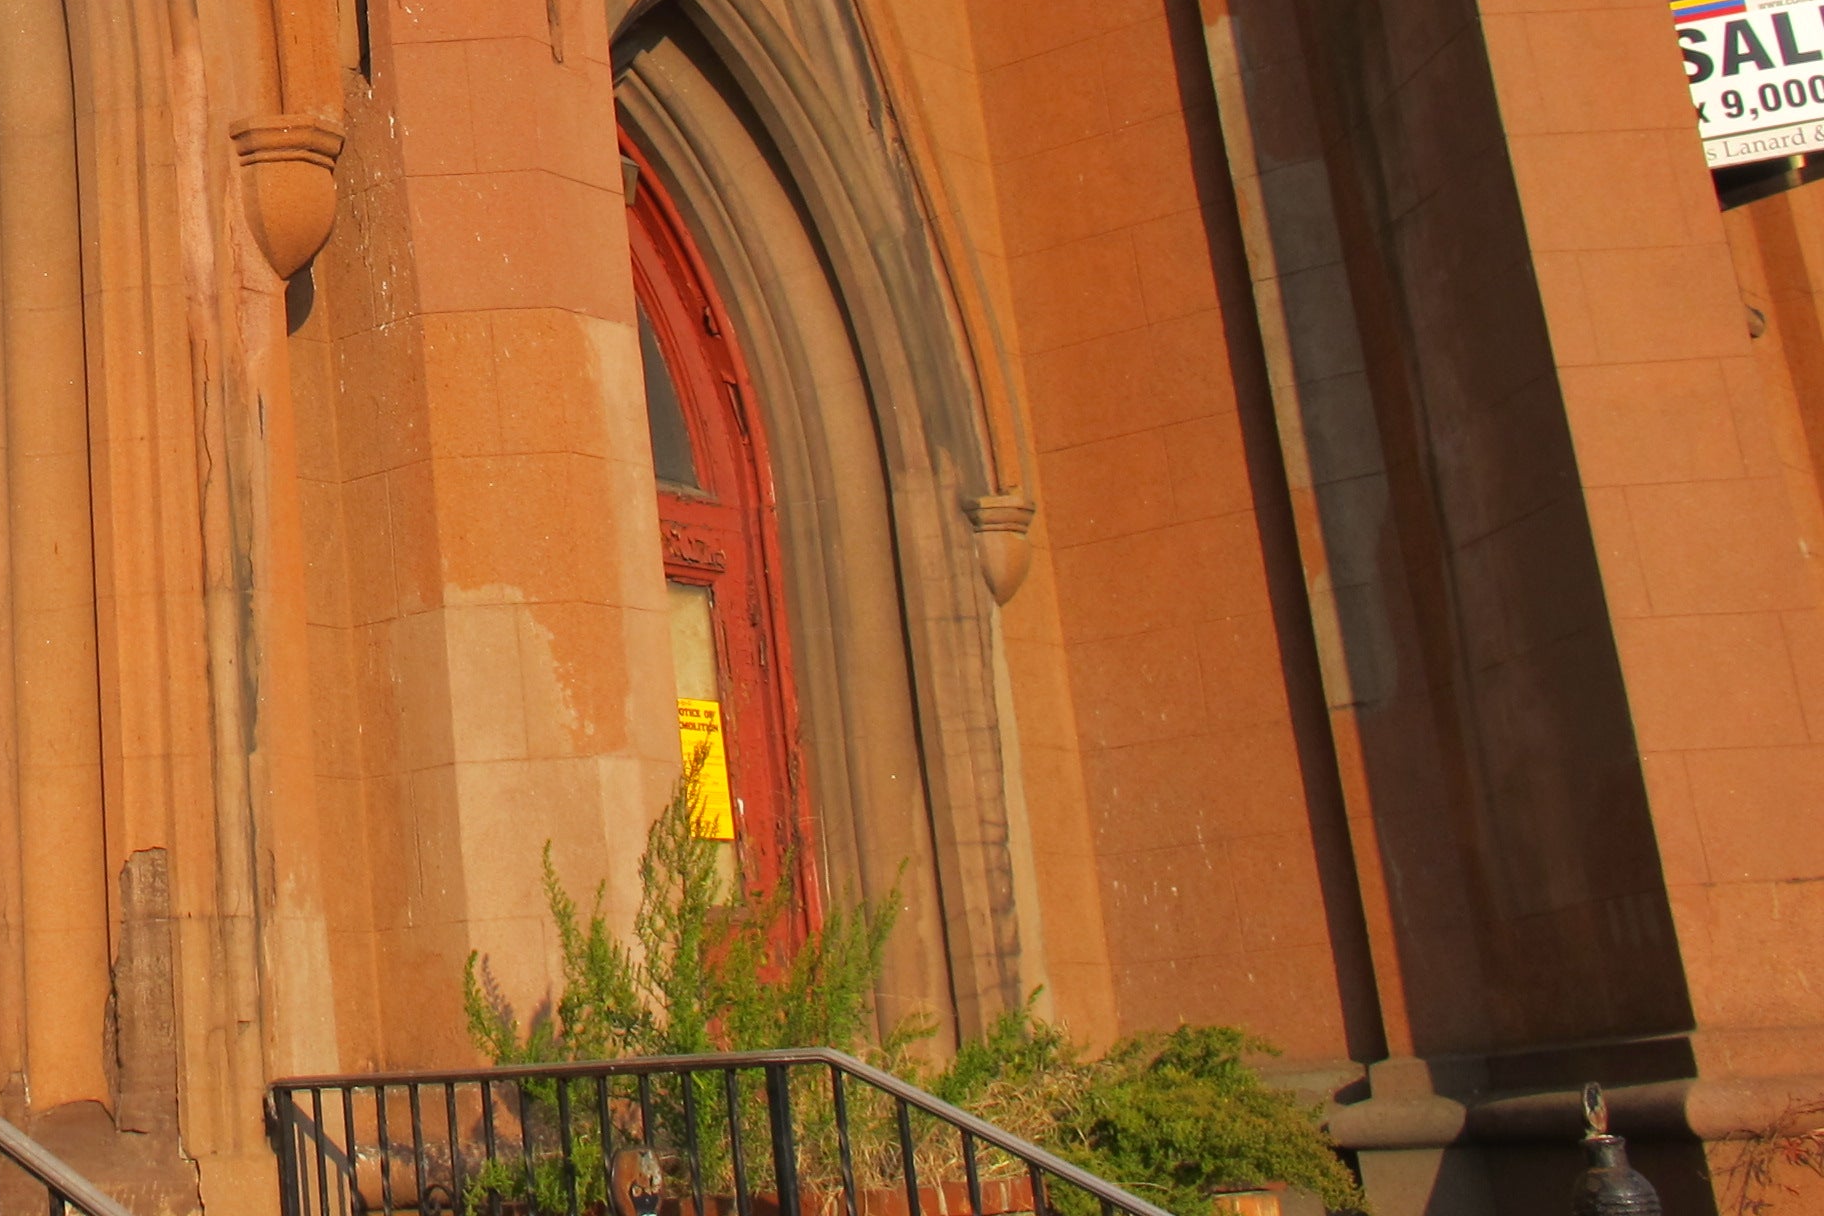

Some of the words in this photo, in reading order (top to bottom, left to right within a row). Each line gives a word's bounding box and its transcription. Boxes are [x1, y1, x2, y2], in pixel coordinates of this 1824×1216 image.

[1677, 4, 1824, 84] SAL
[1723, 127, 1807, 158] Lanard
[703, 709, 716, 719] OF
